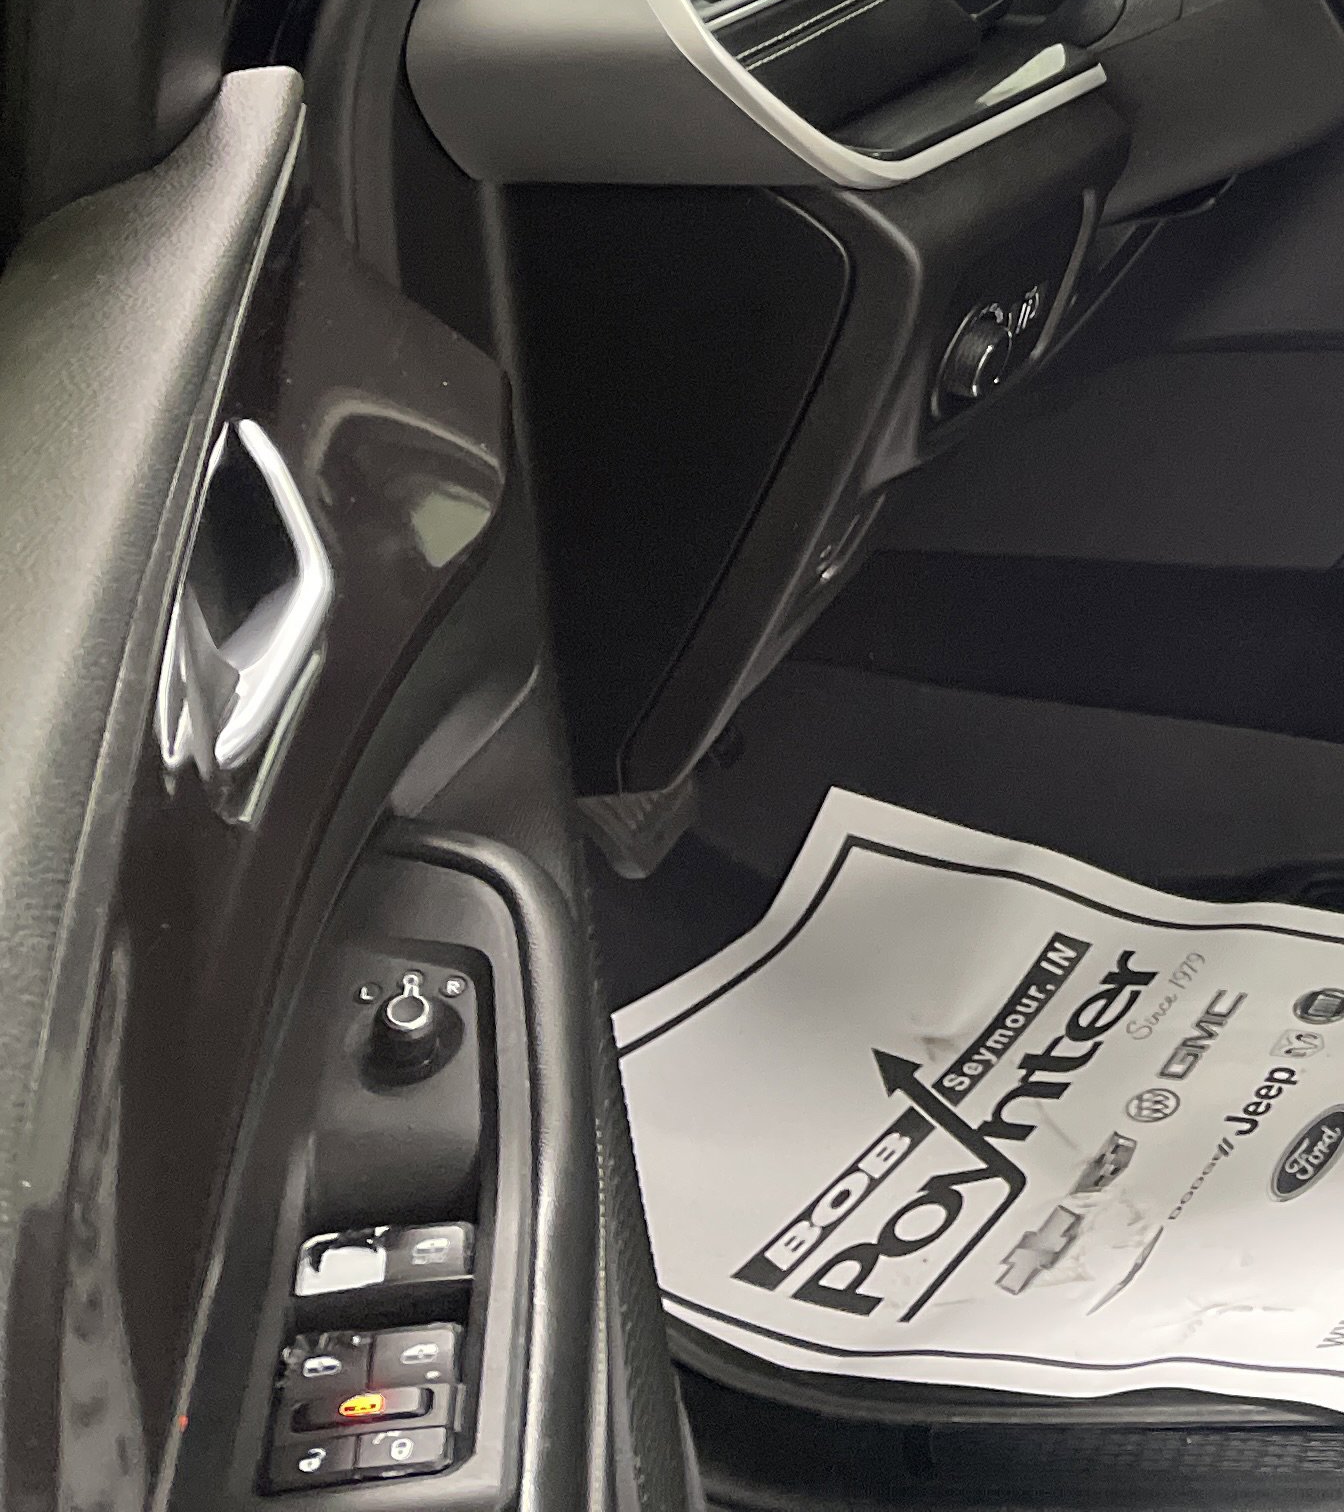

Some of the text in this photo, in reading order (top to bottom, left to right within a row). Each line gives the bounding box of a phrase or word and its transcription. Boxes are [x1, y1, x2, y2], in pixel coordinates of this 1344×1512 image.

[360, 986, 373, 1000] L
[446, 980, 460, 995] R
[943, 941, 1079, 1092] Seymour, IN
[1126, 952, 1206, 1040] Since 1979
[1156, 989, 1248, 1080] GMC
[1224, 1067, 1298, 1136] Jeep
[1285, 1125, 1341, 1180] Ford
[763, 1132, 912, 1271] BOB
